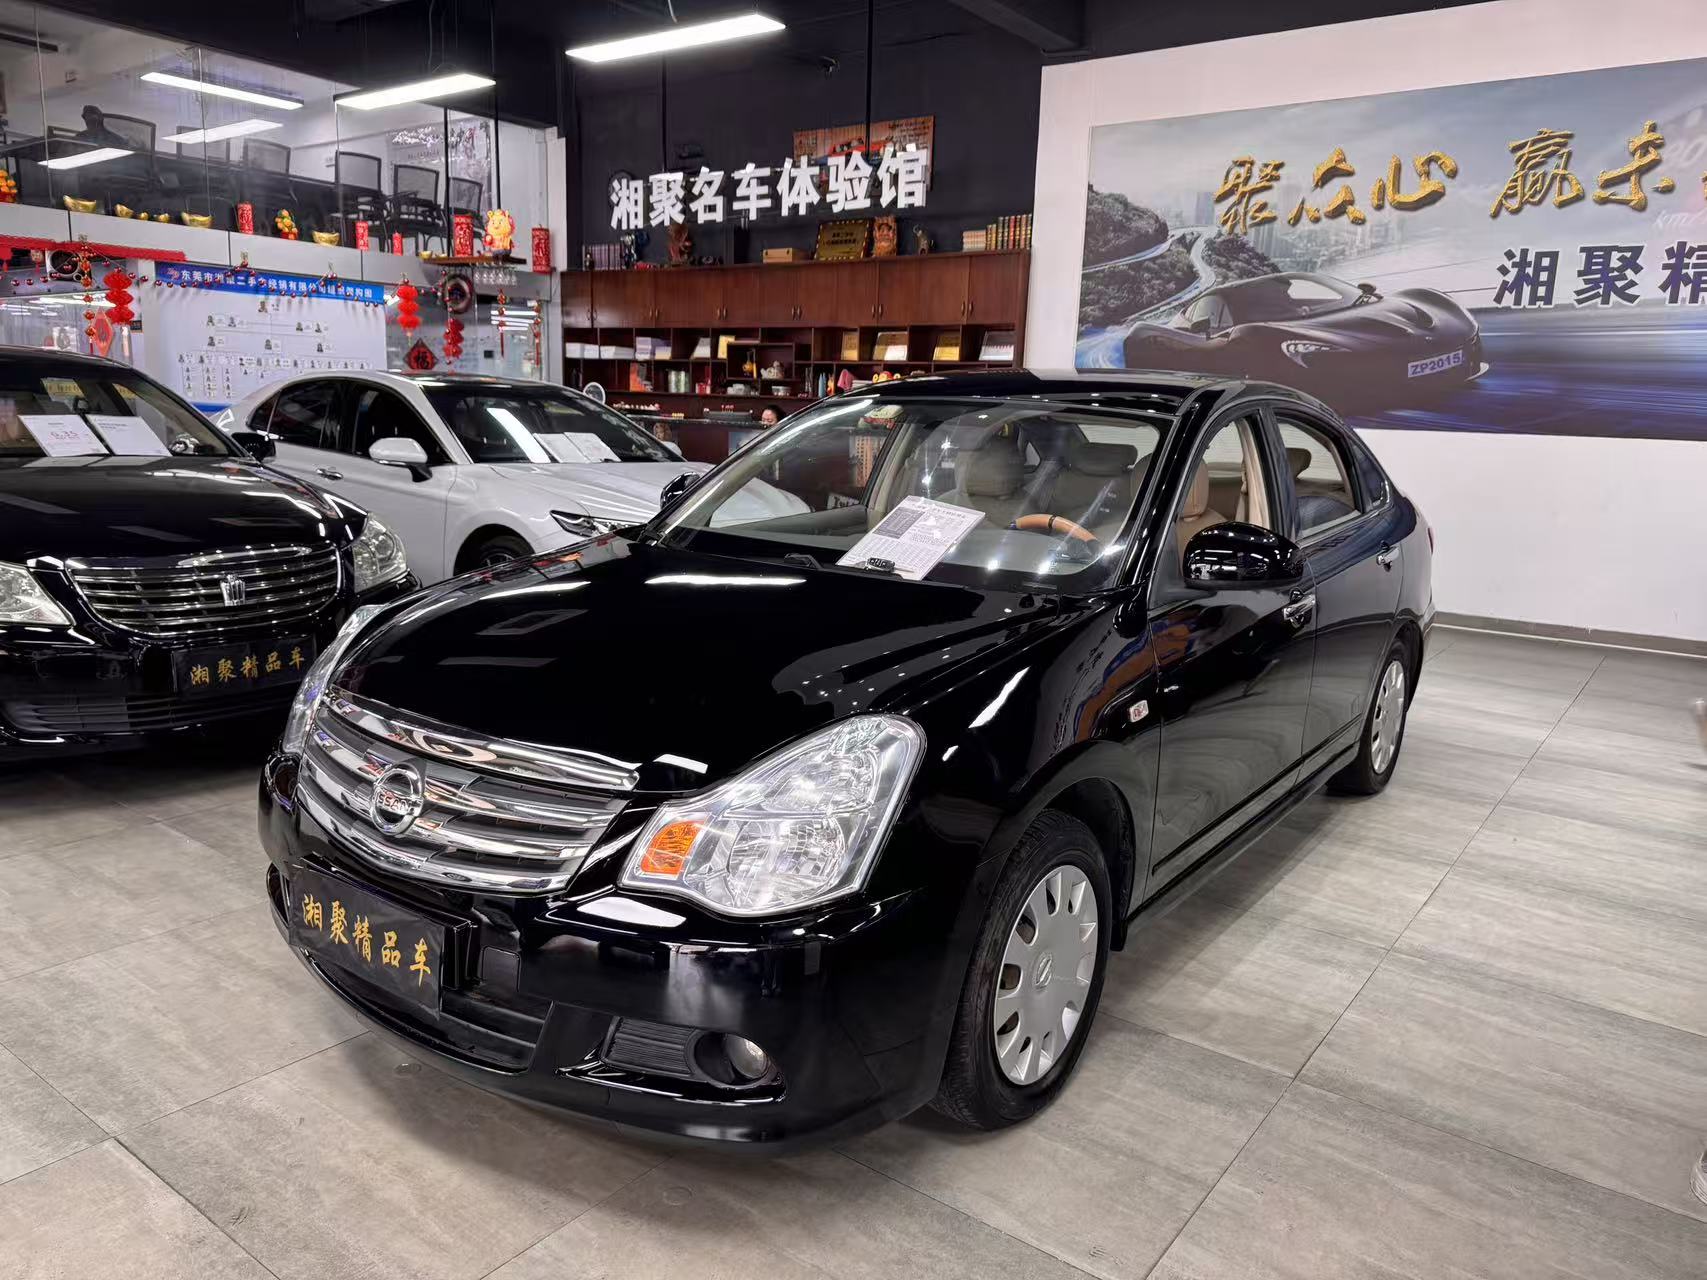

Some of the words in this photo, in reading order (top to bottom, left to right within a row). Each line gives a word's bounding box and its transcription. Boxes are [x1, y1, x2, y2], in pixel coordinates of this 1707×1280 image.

[610, 143, 927, 230] 湘聚名车体验馆
[1213, 148, 1457, 234] 聚众心
[1410, 352, 1462, 375] ZP2015
[190, 646, 305, 686] 湘聚精品车
[301, 893, 431, 987] 湘聚精品车
